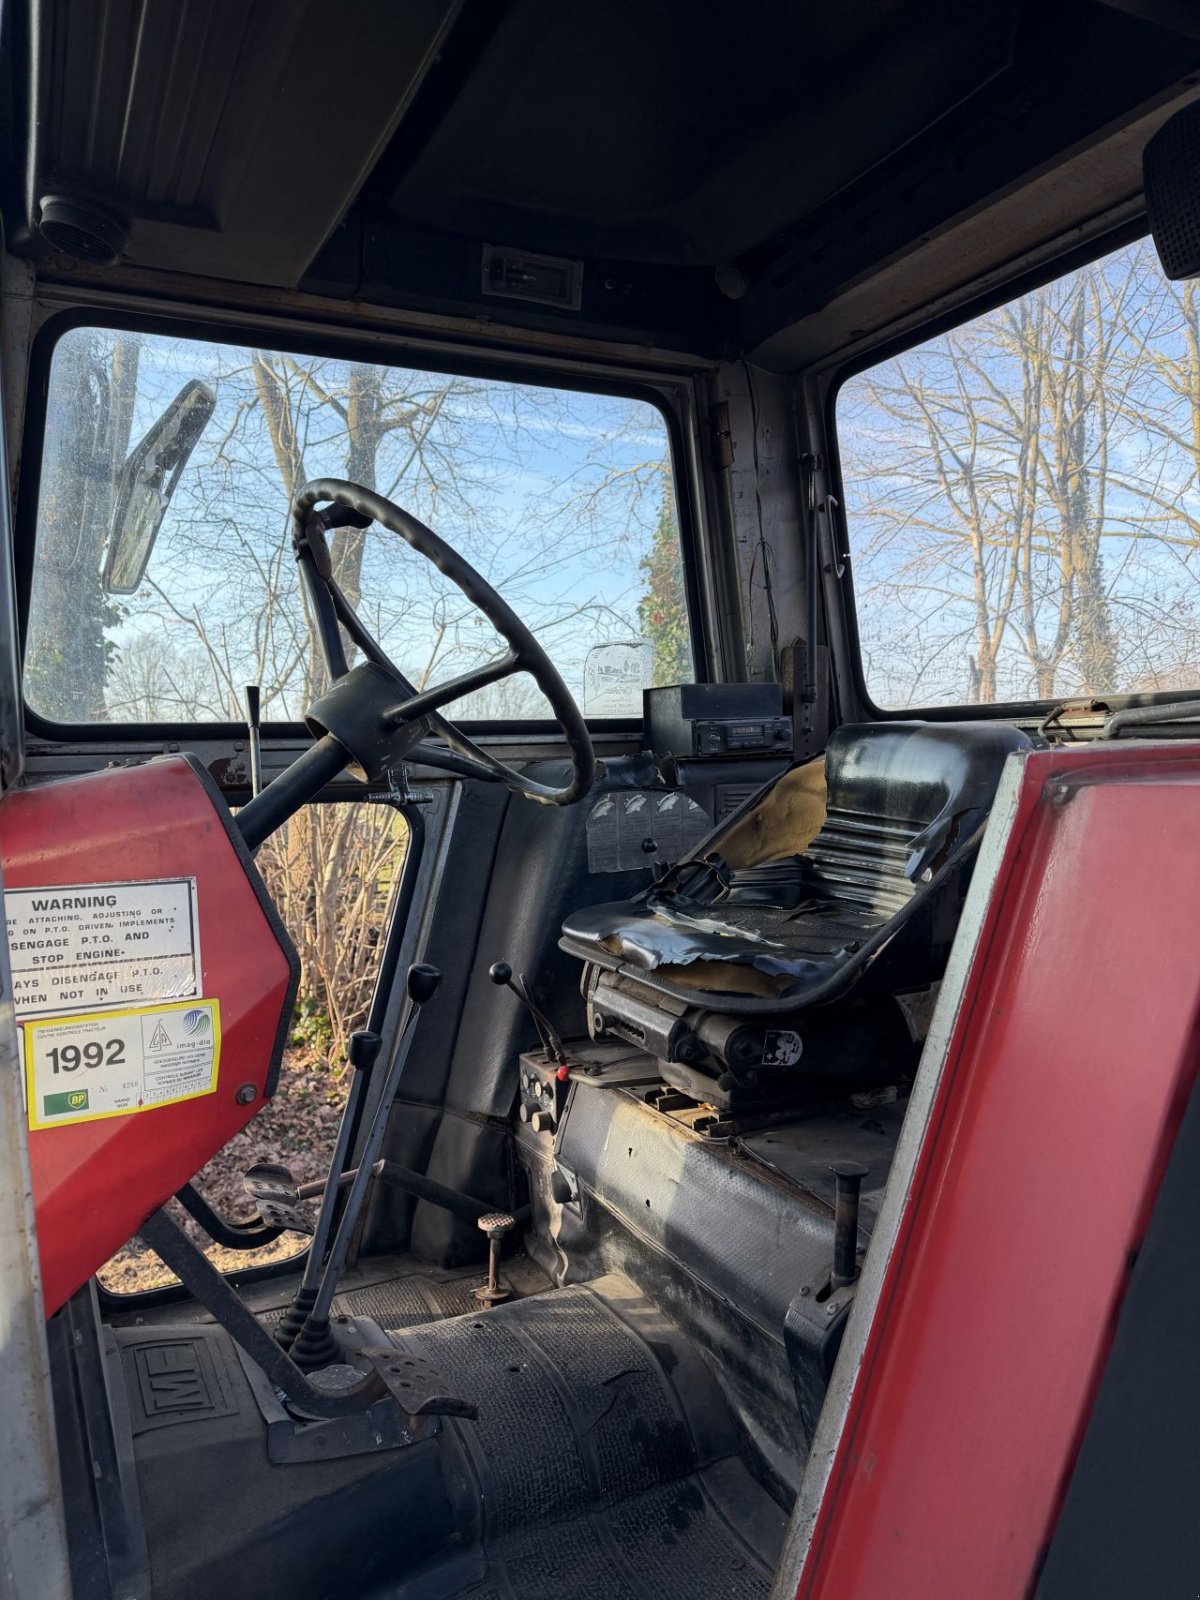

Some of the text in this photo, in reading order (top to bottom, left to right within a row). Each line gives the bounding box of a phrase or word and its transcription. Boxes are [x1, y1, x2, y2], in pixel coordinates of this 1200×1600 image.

[32, 895, 117, 911] WARNING
[29, 914, 83, 924] ATTACHING,
[92, 910, 142, 919] ADJUSTING
[22, 928, 37, 936] ON
[44, 925, 71, 934] P.T.O.
[119, 917, 175, 928] IMPLEMENTS
[10, 931, 150, 951] SENGAGE P.T.O. AND
[32, 954, 64, 965] STOP
[14, 979, 40, 990] AYS
[59, 990, 84, 1000] NOT
[96, 987, 108, 996] IN
[120, 984, 143, 993] USE
[46, 1039, 126, 1074] 1992
[71, 1095, 85, 1105] BP
[143, 1349, 205, 1411] MF
